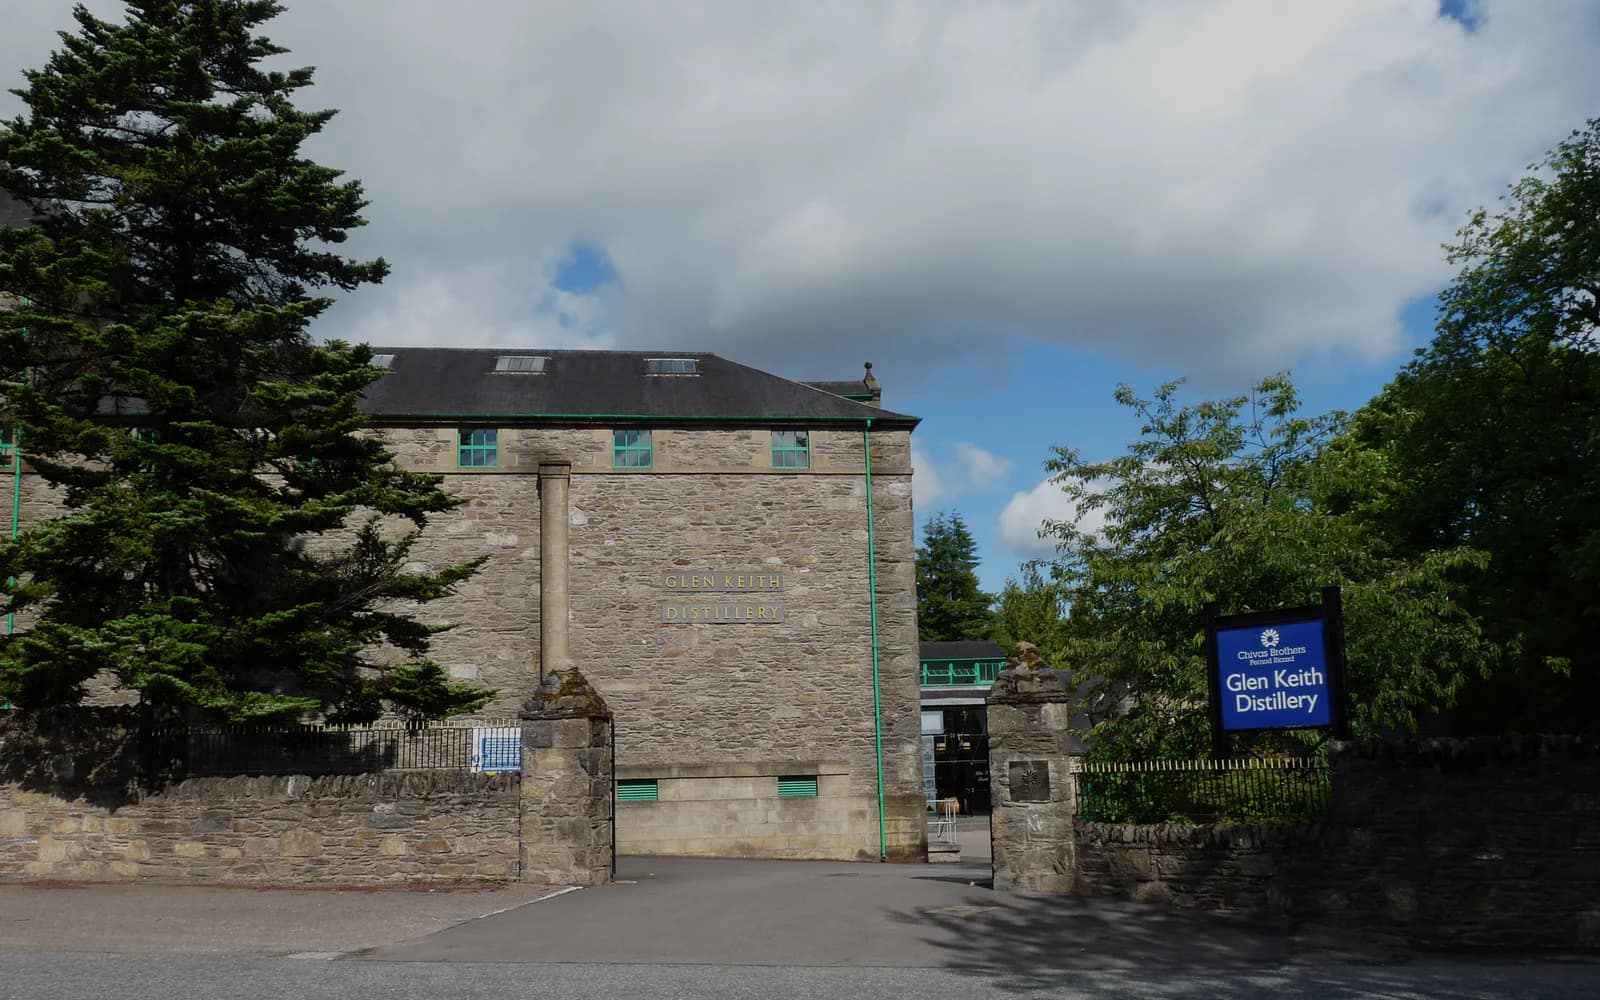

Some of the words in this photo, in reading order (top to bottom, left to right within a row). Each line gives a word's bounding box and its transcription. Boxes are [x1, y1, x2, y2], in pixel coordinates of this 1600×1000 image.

[665, 575, 714, 588] GLEN
[725, 575, 780, 588] KEITH
[667, 607, 779, 619] DISTILLERY
[1238, 650, 1268, 660] Chivas
[1270, 646, 1306, 657] Brothers
[1226, 673, 1268, 692] Glen
[1274, 666, 1324, 688] Keith
[1236, 691, 1318, 713] Distillery
